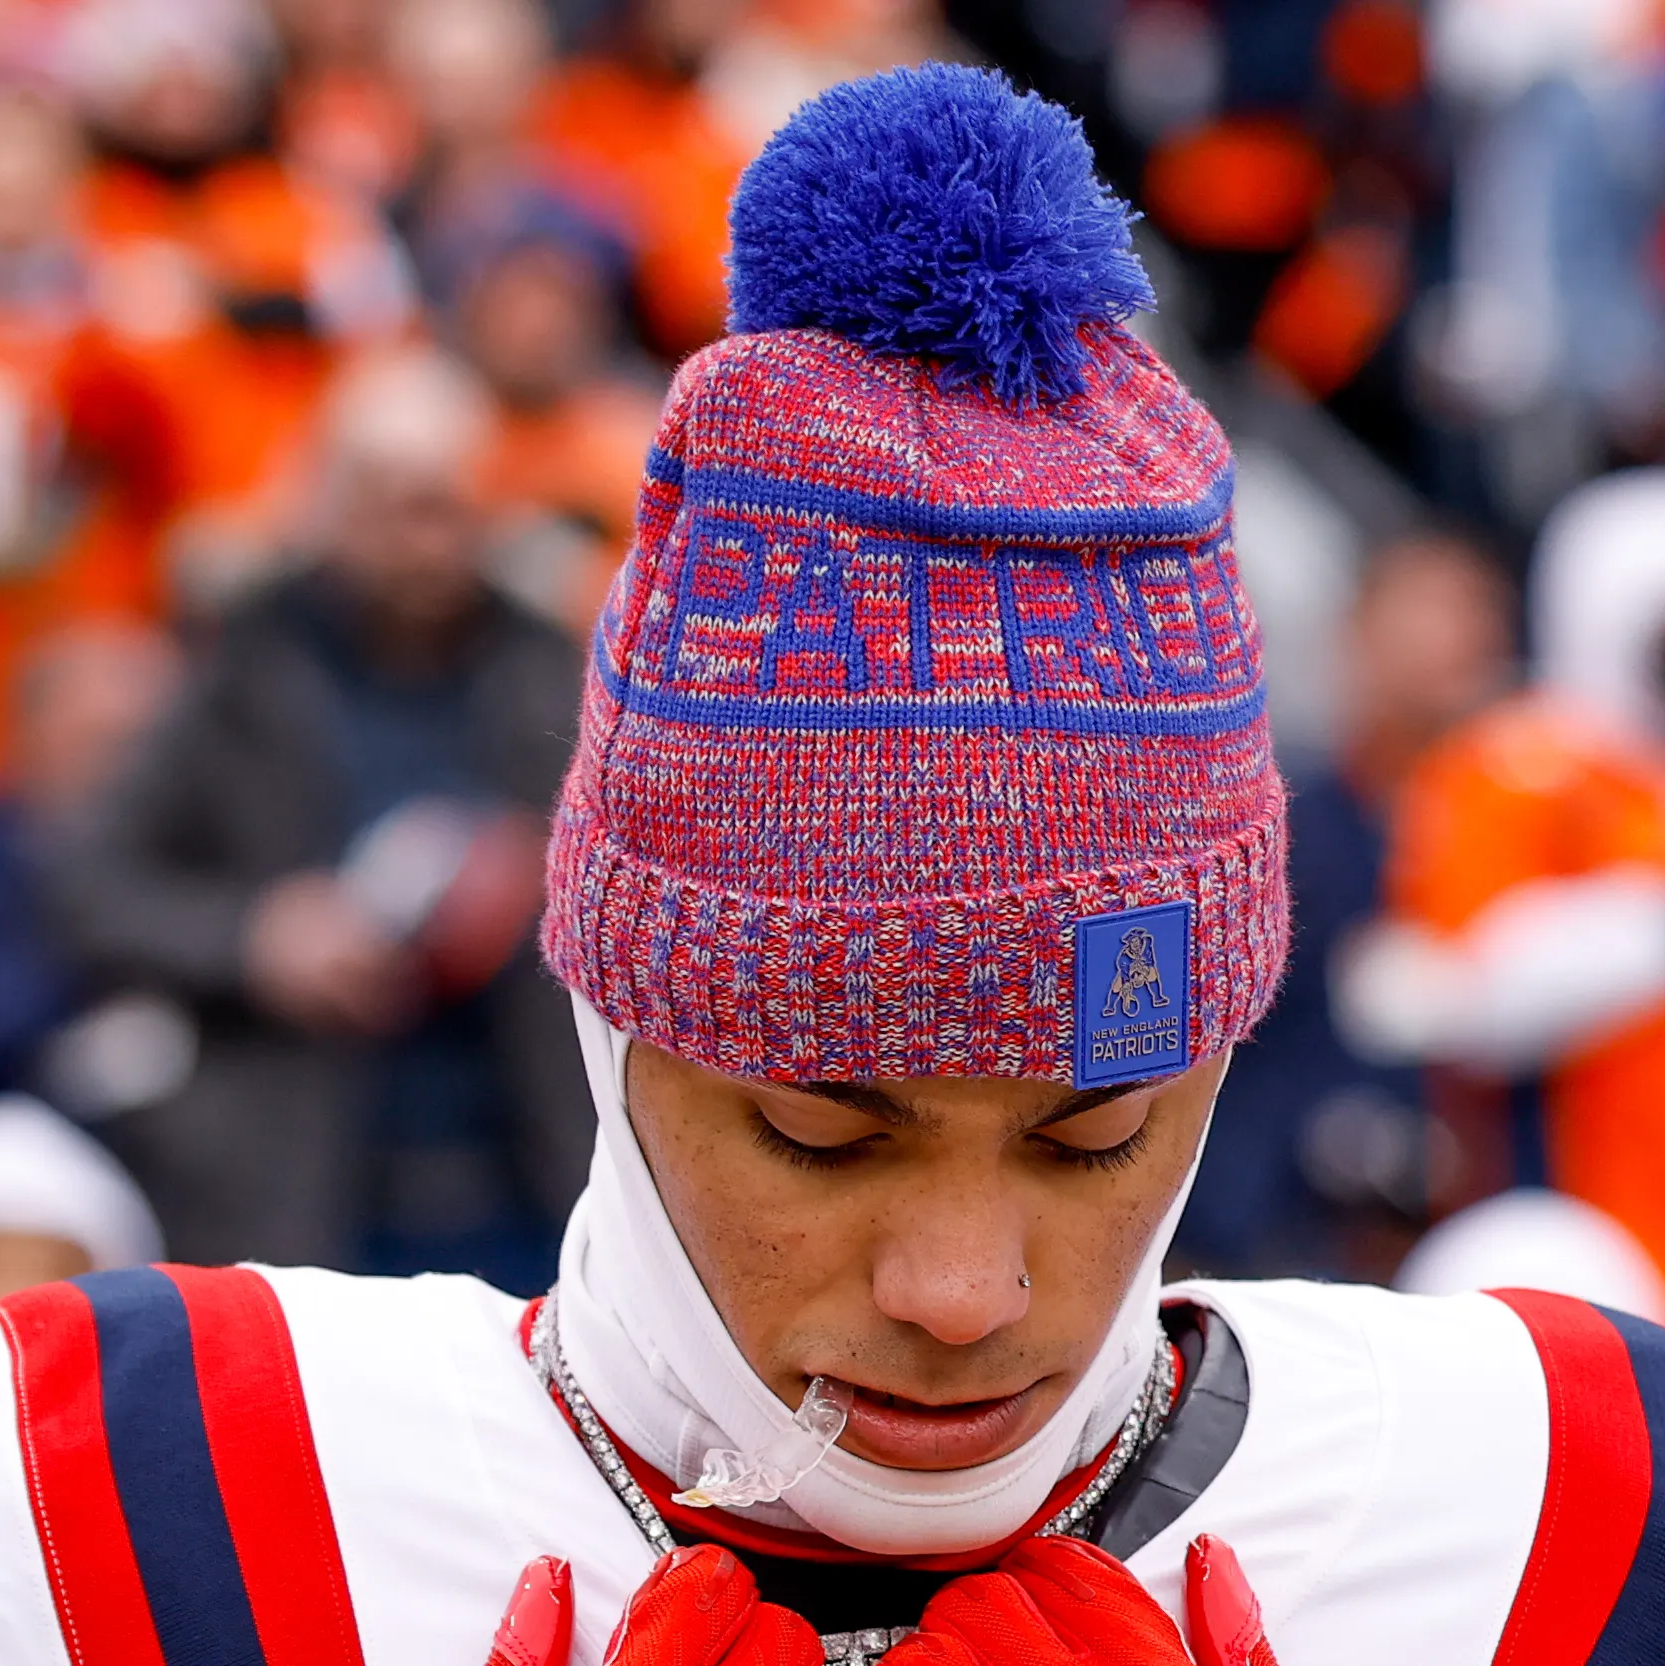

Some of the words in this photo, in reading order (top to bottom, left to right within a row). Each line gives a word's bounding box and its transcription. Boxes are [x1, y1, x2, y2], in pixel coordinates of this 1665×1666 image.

[1092, 1029, 1118, 1040] NEW
[1124, 1016, 1178, 1034] ENGLAND
[1092, 1030, 1178, 1063] PATRIOTS
